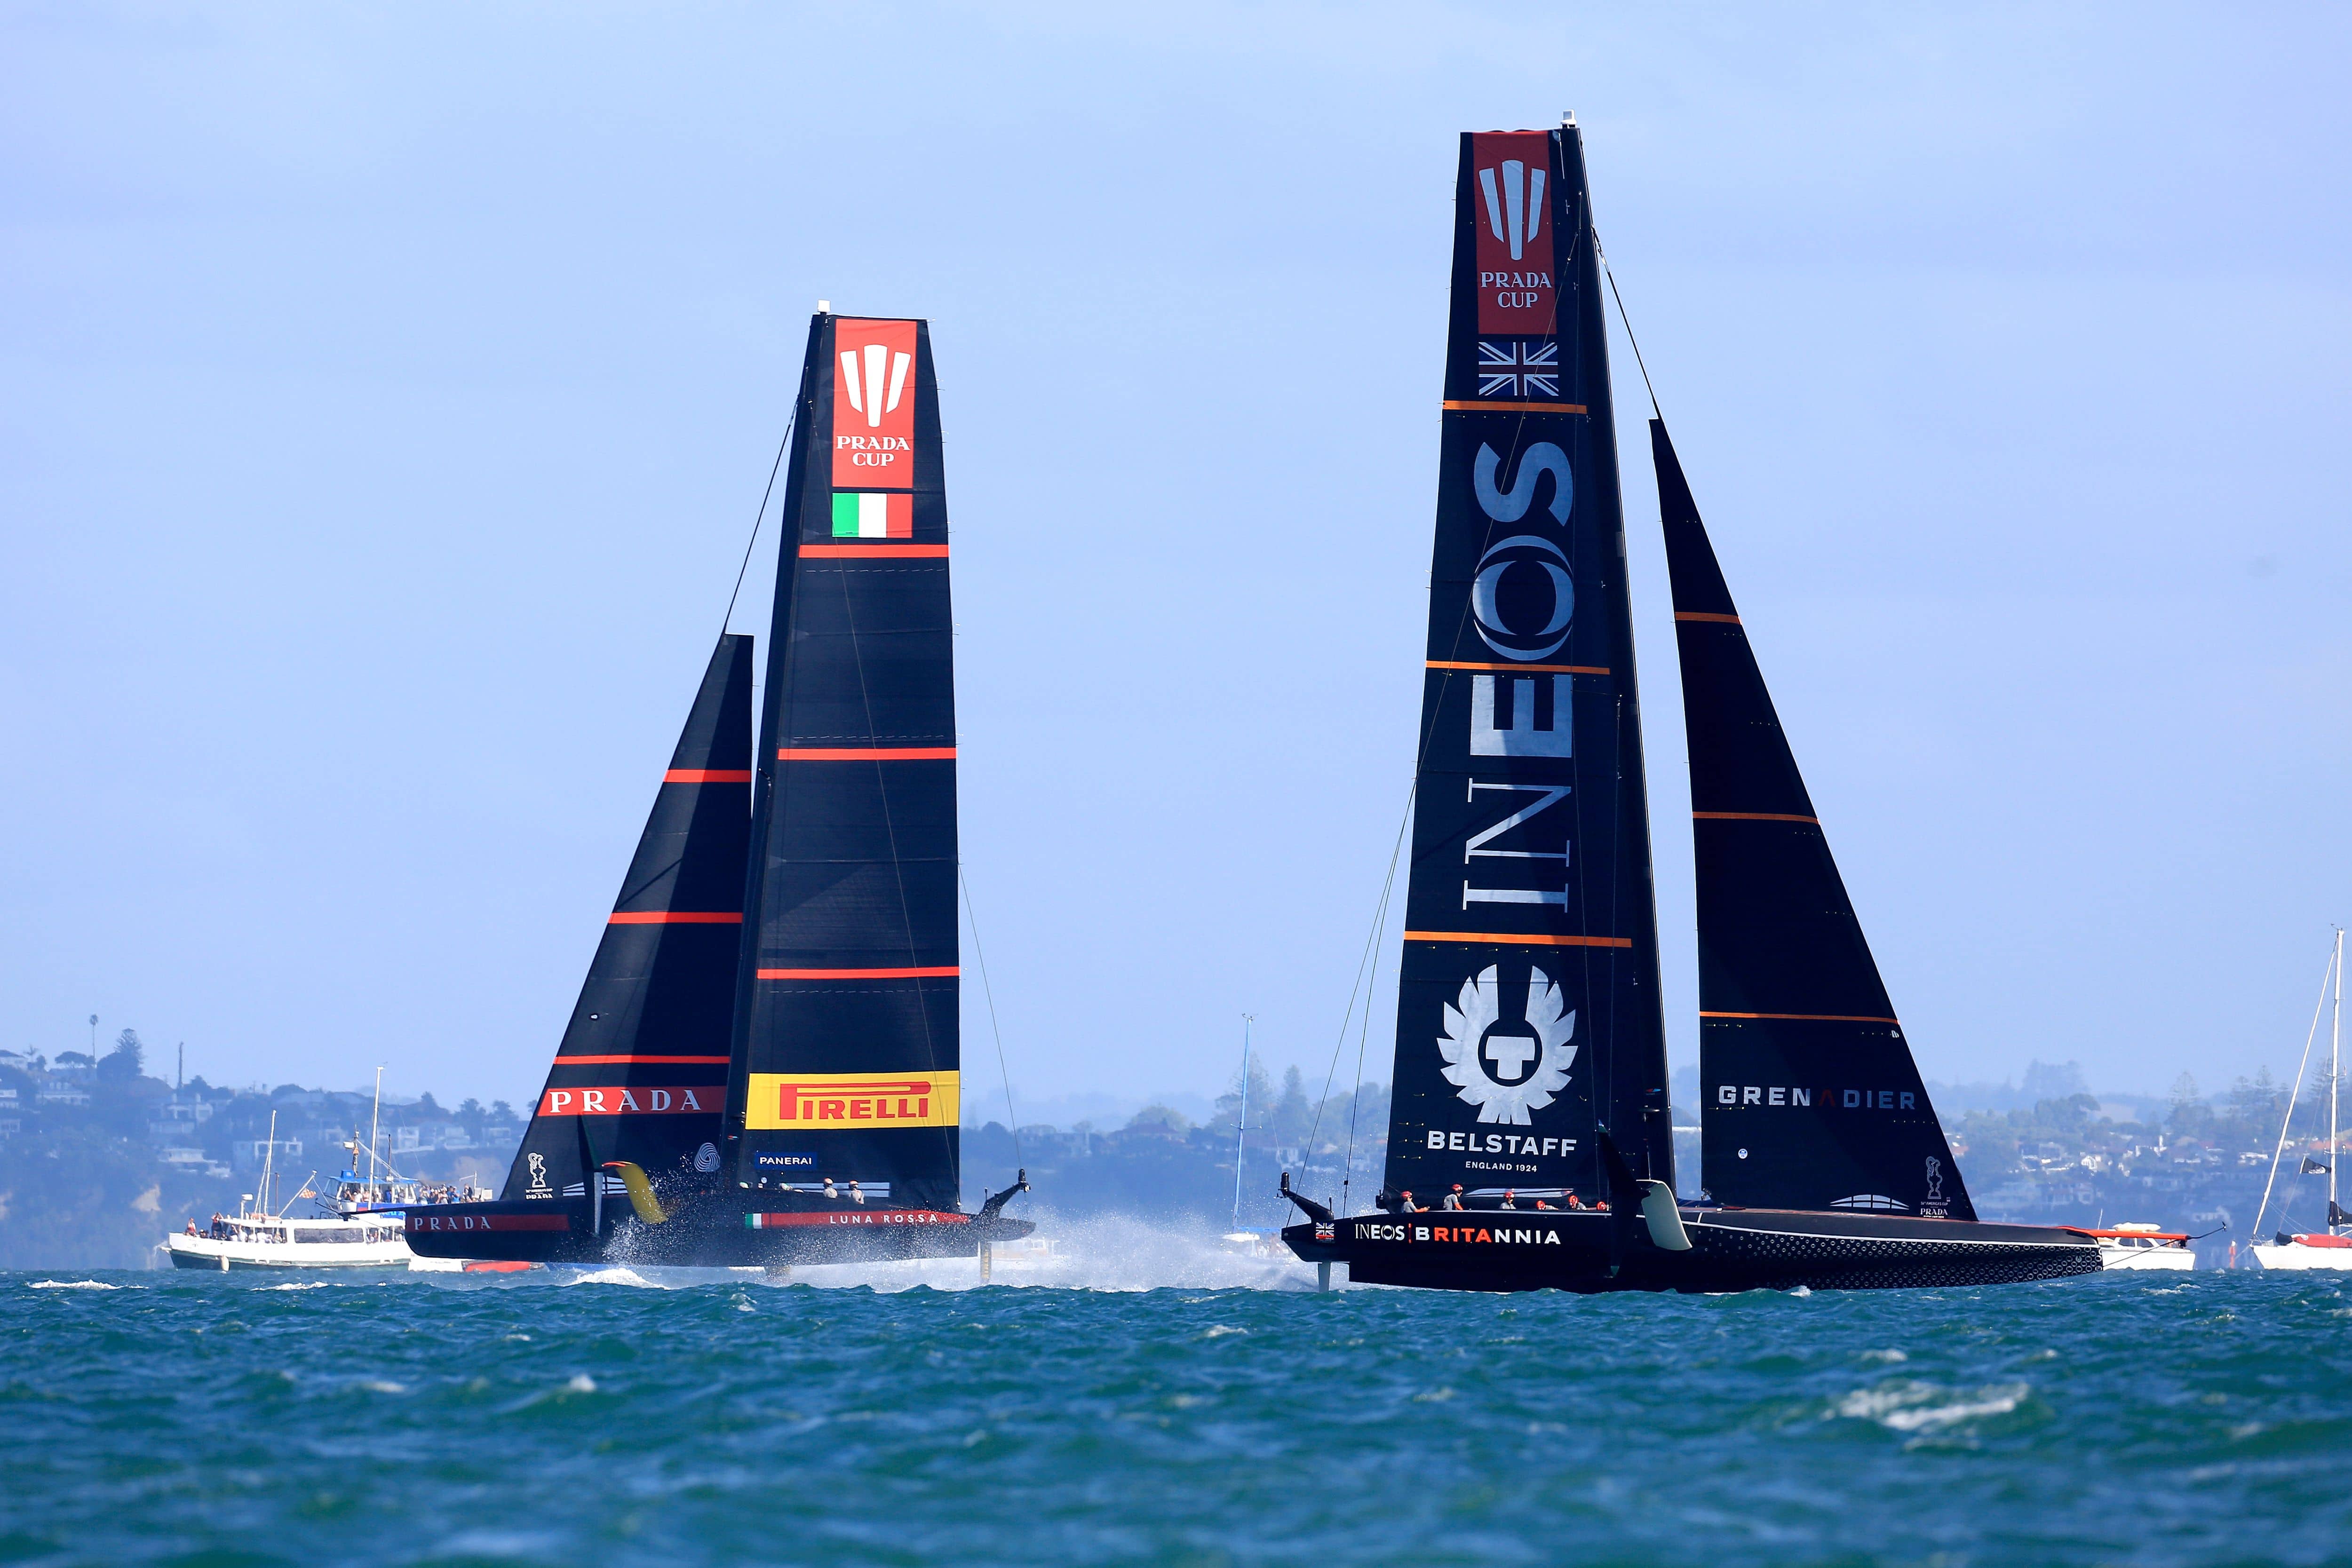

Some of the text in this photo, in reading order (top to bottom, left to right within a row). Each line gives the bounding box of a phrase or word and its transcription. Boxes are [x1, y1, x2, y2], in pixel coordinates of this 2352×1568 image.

[1480, 271, 1552, 288] PRADA
[1497, 291, 1538, 308] CUP
[836, 436, 911, 451] PRADA
[852, 452, 894, 467] CUP
[1462, 442, 1574, 913] INEOS
[549, 1089, 701, 1113] PRADA
[779, 1081, 931, 1120] PIRELLI
[1718, 1085, 1915, 1110] GRENADIER
[1427, 1130, 1577, 1157] BELSTAFF
[759, 1156, 812, 1165] PANERAI
[1465, 1161, 1537, 1172] ENGLAND 1924
[414, 1216, 492, 1230] PRADA
[830, 1214, 938, 1224] LUNA ROSSA
[1355, 1224, 1561, 1245] INEOS BRITANNIA
